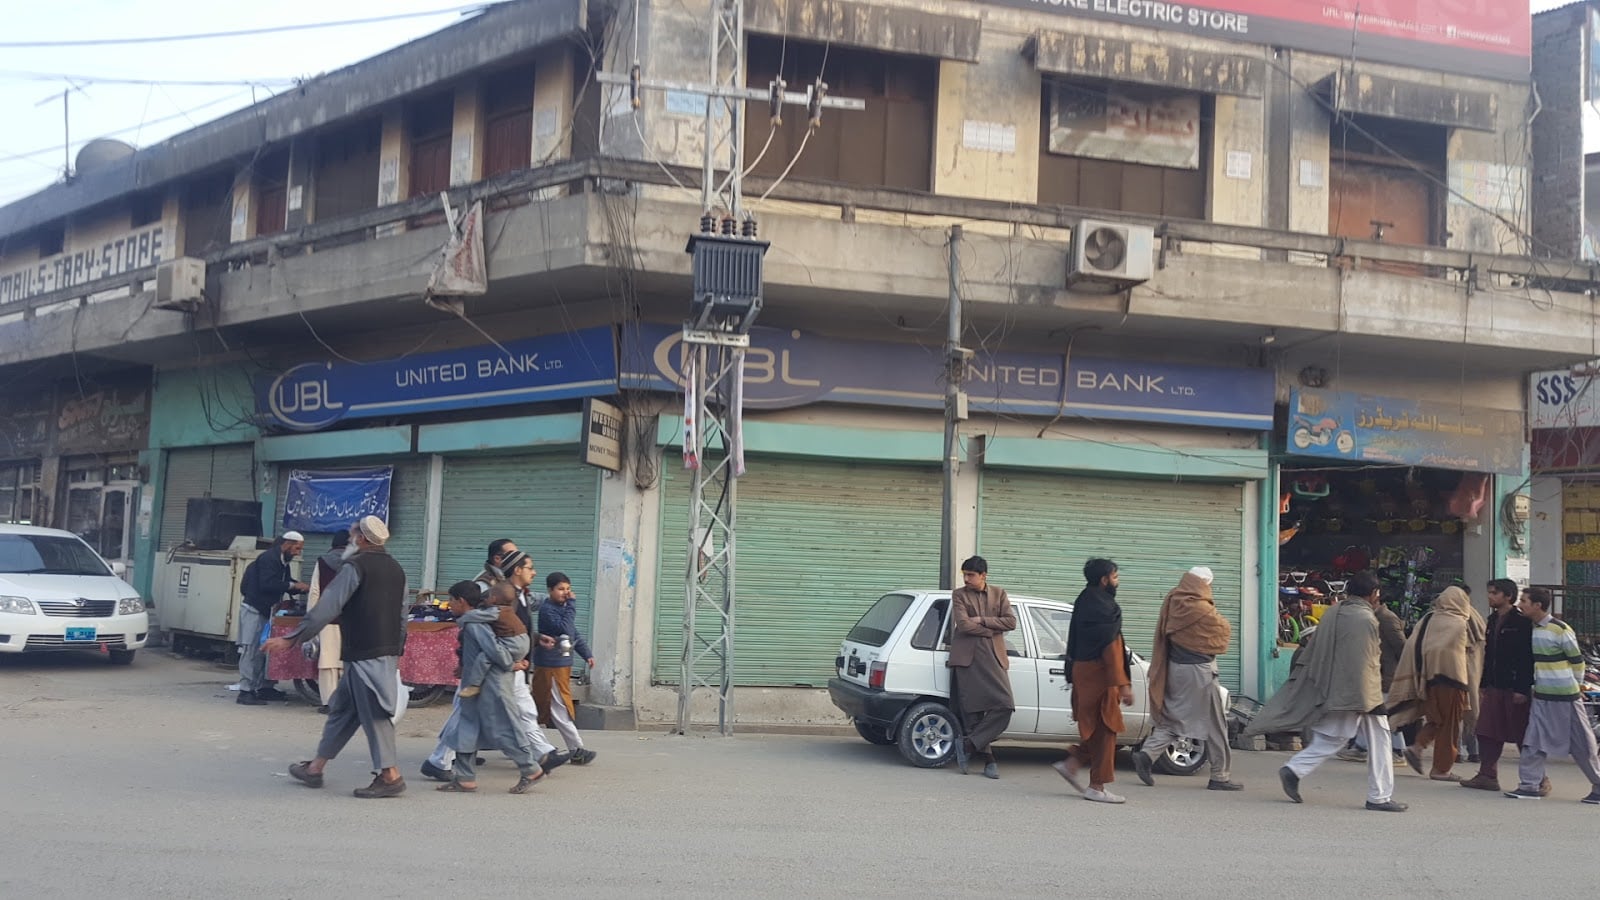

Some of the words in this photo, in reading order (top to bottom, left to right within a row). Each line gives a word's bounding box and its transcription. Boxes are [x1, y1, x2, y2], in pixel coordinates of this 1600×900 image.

[1093, 0, 1183, 23] ELECTRIC
[1188, 8, 1248, 34] STORE
[101, 227, 163, 278] STORE
[396, 362, 467, 387] UNITED
[477, 353, 540, 378] BANK
[544, 359, 564, 370] LTD.
[962, 363, 1059, 386] NITED
[1077, 371, 1164, 394] BANK
[1171, 386, 1196, 396] LTD.
[279, 379, 343, 413] UBL
[1536, 374, 1577, 405] SSS
